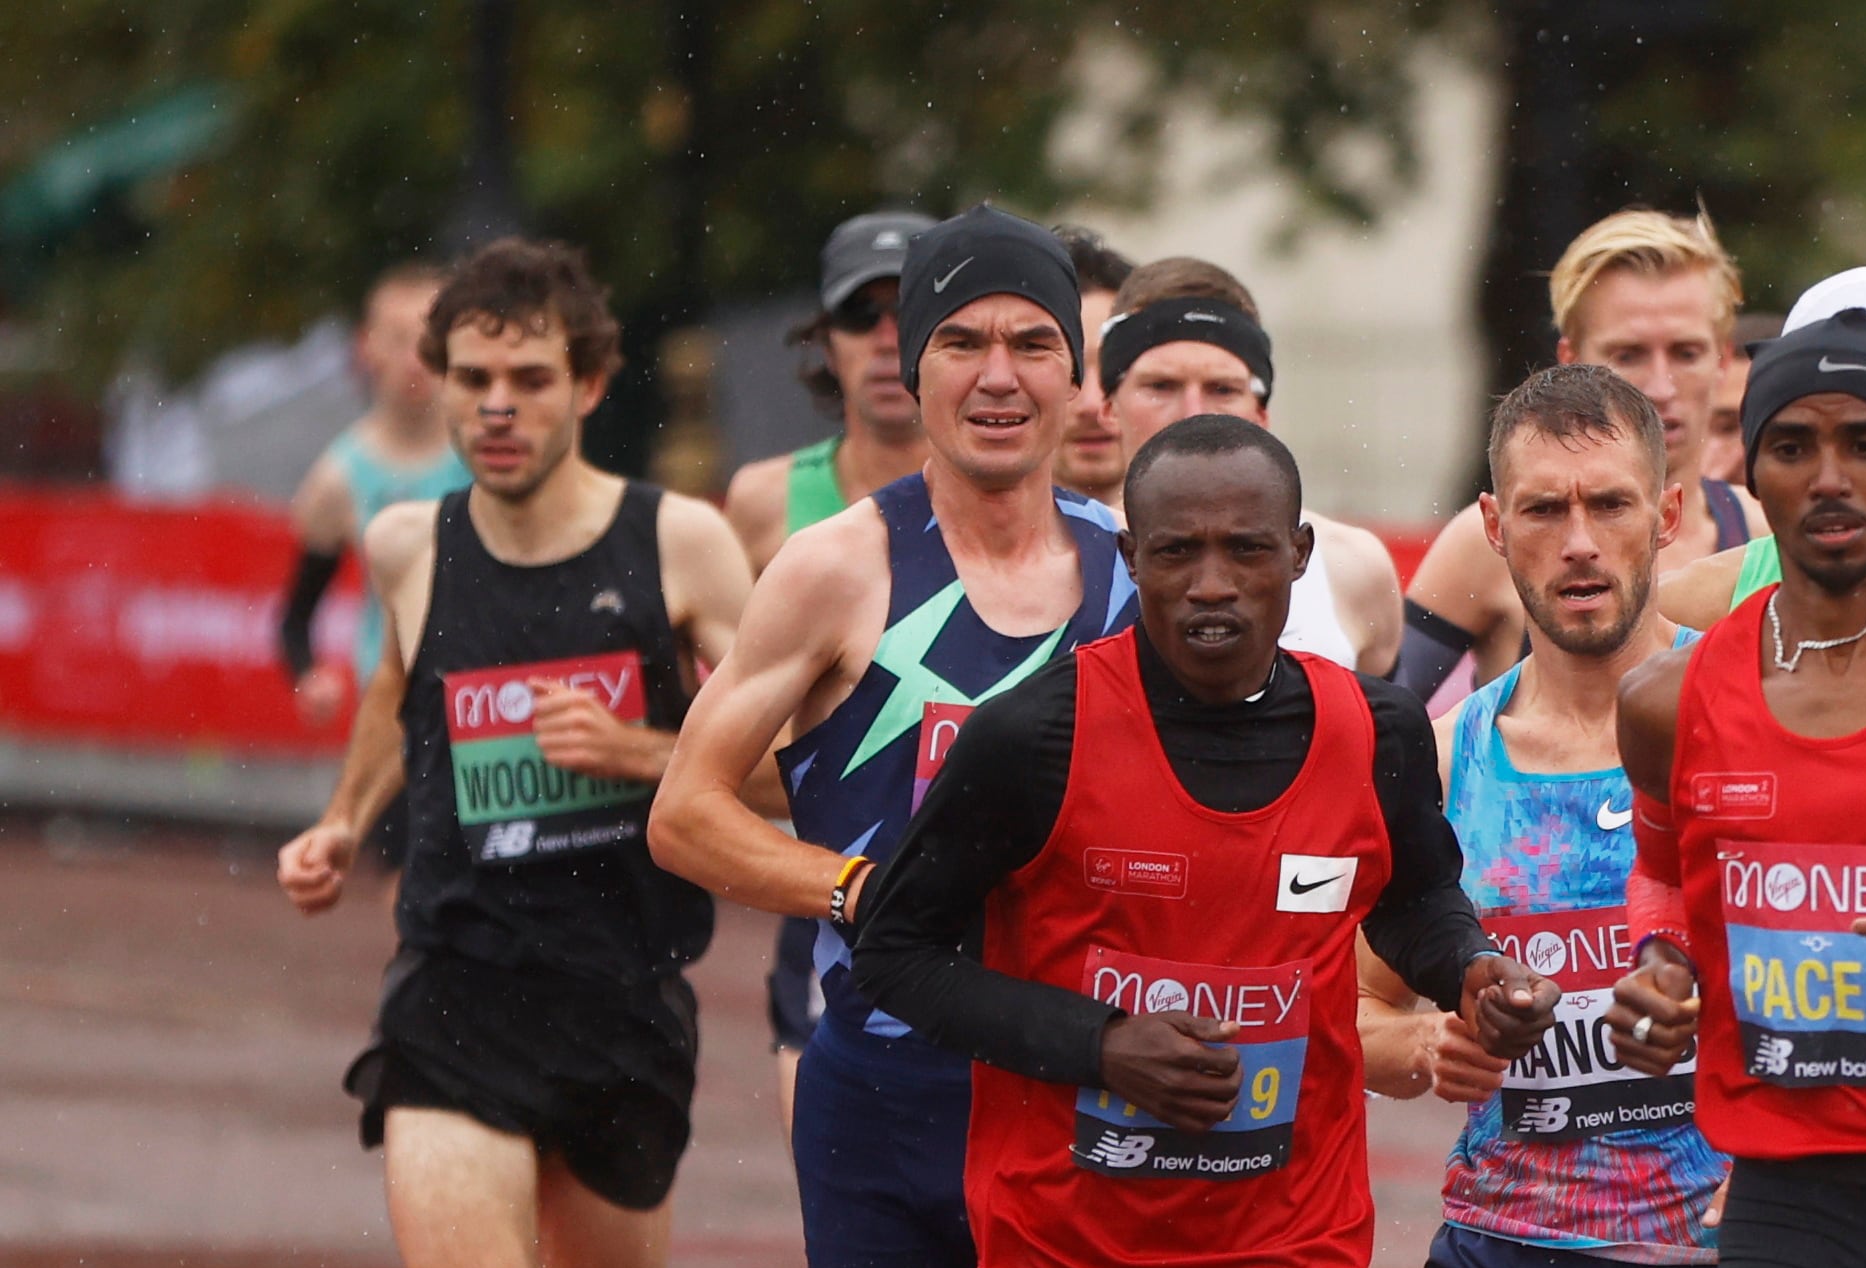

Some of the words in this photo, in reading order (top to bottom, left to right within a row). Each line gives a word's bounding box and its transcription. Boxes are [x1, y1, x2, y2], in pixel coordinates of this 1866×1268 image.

[455, 667, 631, 729] MOY
[1127, 871, 1181, 882] MARATHON
[1128, 861, 1170, 872] LONDON
[1093, 966, 1302, 1026] MONEY
[1744, 953, 1866, 1020] PACE
[1795, 1060, 1836, 1078] new
[1250, 1066, 1281, 1120] 9
[1576, 1110, 1614, 1129] new
[1618, 1100, 1696, 1123] balance
[1153, 1155, 1194, 1171] new
[1197, 1153, 1272, 1173] balance
